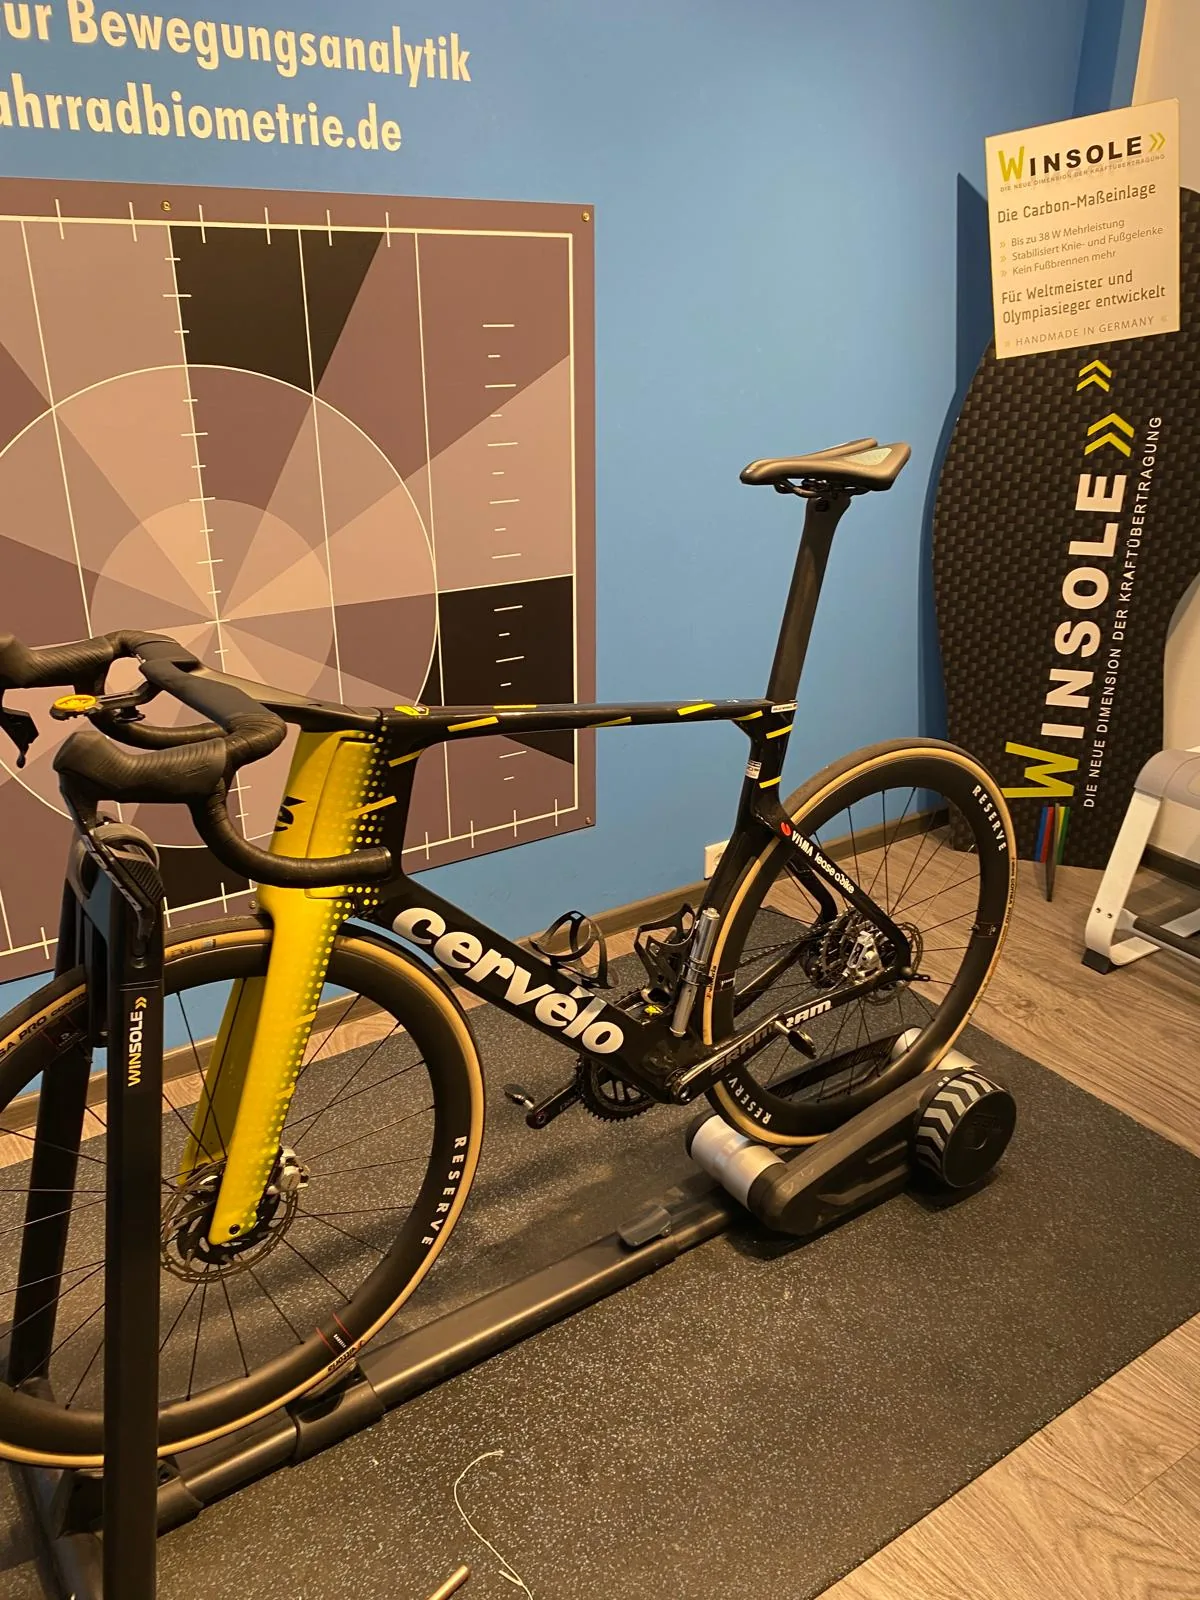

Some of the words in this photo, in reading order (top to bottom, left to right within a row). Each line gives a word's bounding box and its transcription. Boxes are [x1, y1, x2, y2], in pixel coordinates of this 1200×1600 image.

[67, 0, 472, 88] Bewegungsanalytik
[998, 135, 1142, 182] WINSOLE
[998, 208, 1018, 223] Die
[1023, 183, 1156, 217] Carbon-Maßeinlage
[1011, 236, 1024, 247] Bis
[1026, 236, 1037, 245] zu
[1039, 232, 1050, 242] 38
[1051, 230, 1062, 240] W
[1063, 219, 1125, 237] Mehrleistung
[1011, 245, 1059, 261] Stabilisiert
[1061, 242, 1086, 252] Knie-
[1087, 236, 1106, 247] und
[1108, 226, 1164, 243] Fußgelenke
[1012, 266, 1032, 276] Kein
[1034, 254, 1089, 272] Fußbrennen
[1091, 249, 1117, 261] mehr
[1001, 291, 1022, 304] Für
[1026, 277, 1104, 300] Weltmeister
[1108, 269, 1133, 286] und
[1003, 299, 1091, 326] Olympiasieger
[1095, 285, 1166, 307] entwickelt
[1015, 328, 1079, 347] HANDMADE
[1083, 326, 1095, 336] IN
[1098, 315, 1154, 333] GERMANY
[1118, 417, 1162, 602] KRAFTÜBERTRAGUNG
[1001, 473, 1127, 798] WINSOLE
[1112, 609, 1129, 641] DER
[1096, 648, 1122, 733] DIMENSION
[1089, 740, 1106, 778] NEUE
[1083, 784, 1098, 808] DIE
[972, 784, 1007, 852] RESERVE
[791, 830, 814, 857] VISMA
[392, 907, 624, 1054] cervélo
[18, 1016, 47, 1041] PRO
[128, 1010, 143, 1087] WINSOLE
[727, 1073, 772, 1125] RESERV
[421, 1135, 468, 1246] RESERVE
